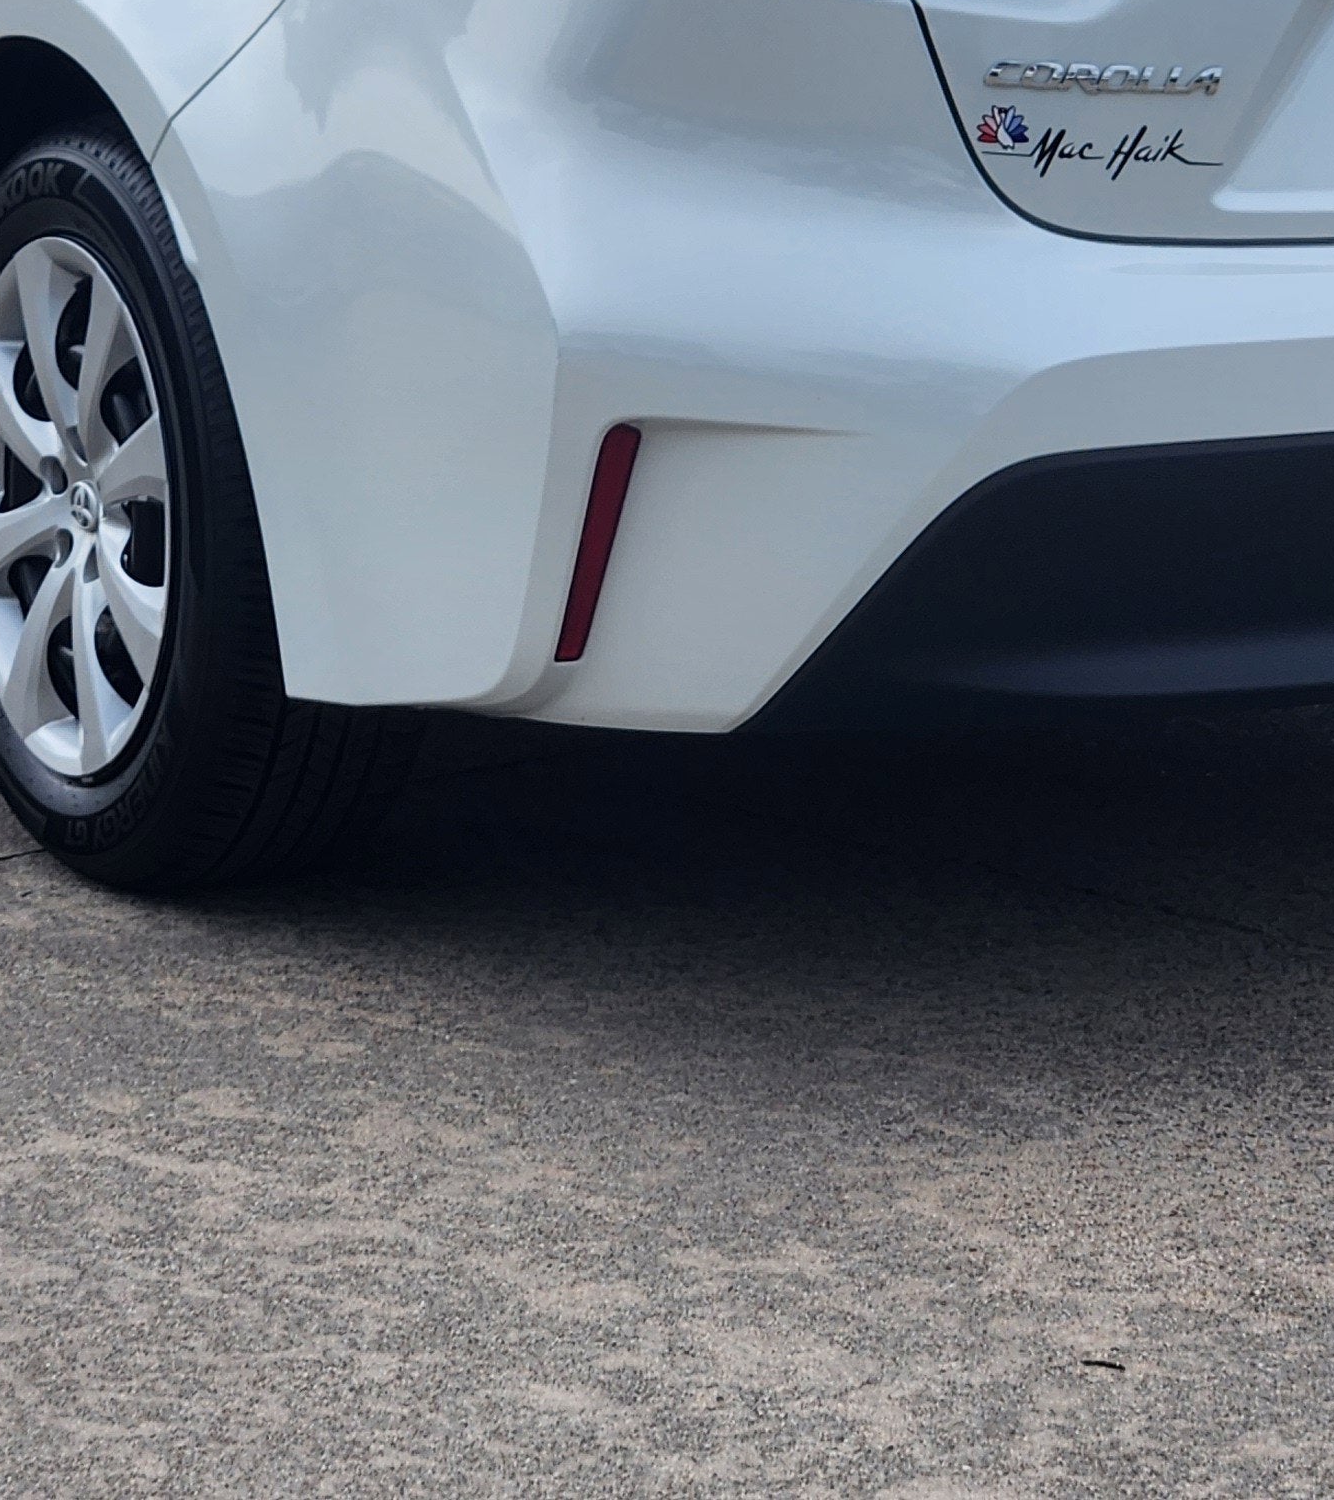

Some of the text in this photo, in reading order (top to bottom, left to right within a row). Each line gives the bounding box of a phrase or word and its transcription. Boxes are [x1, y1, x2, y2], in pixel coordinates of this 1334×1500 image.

[983, 59, 1224, 95] COROLLA
[1029, 124, 1223, 181] Mac Haik
